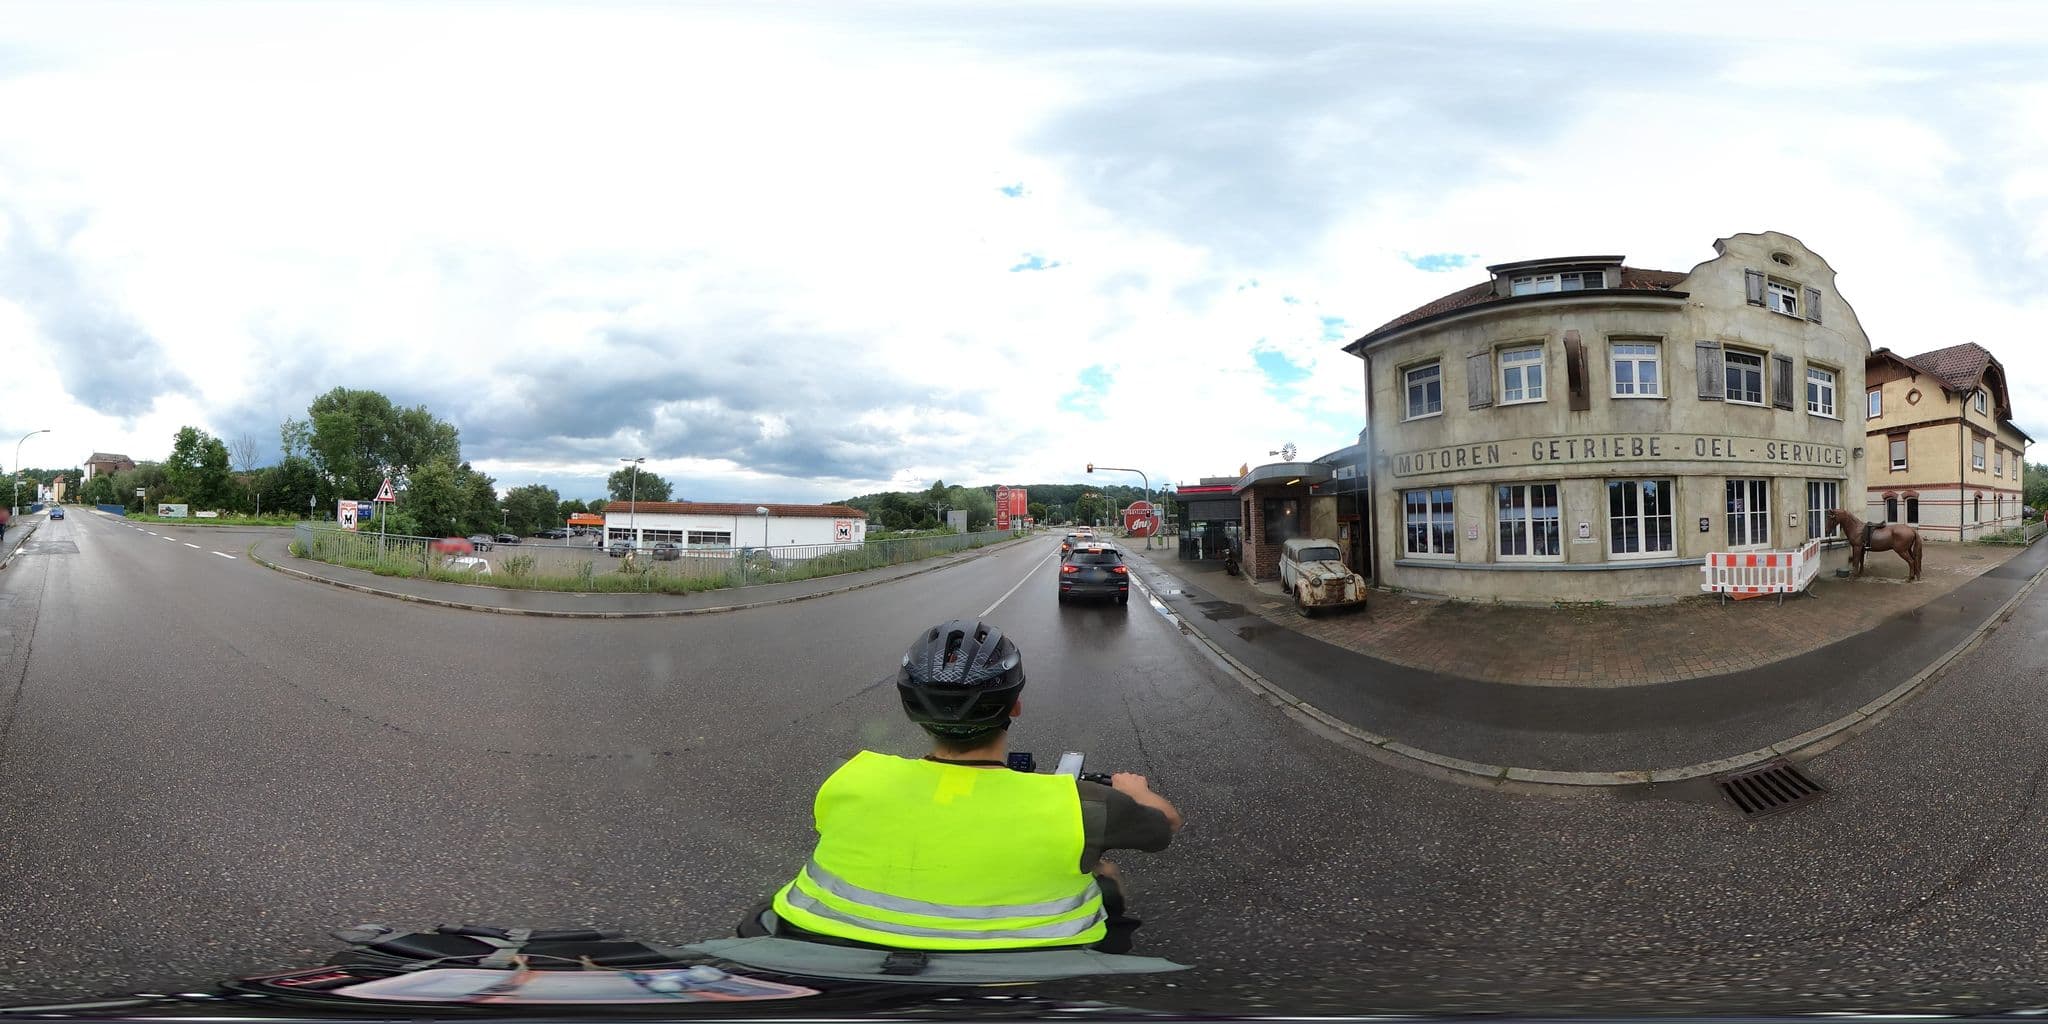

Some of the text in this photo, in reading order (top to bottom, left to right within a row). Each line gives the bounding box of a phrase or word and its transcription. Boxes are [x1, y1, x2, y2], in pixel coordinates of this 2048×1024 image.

[1399, 444, 1499, 473] MOTOREN
[1531, 437, 1662, 461] GETRIEBE
[1695, 437, 1737, 458] OEL
[1766, 442, 1843, 465] SERVICE
